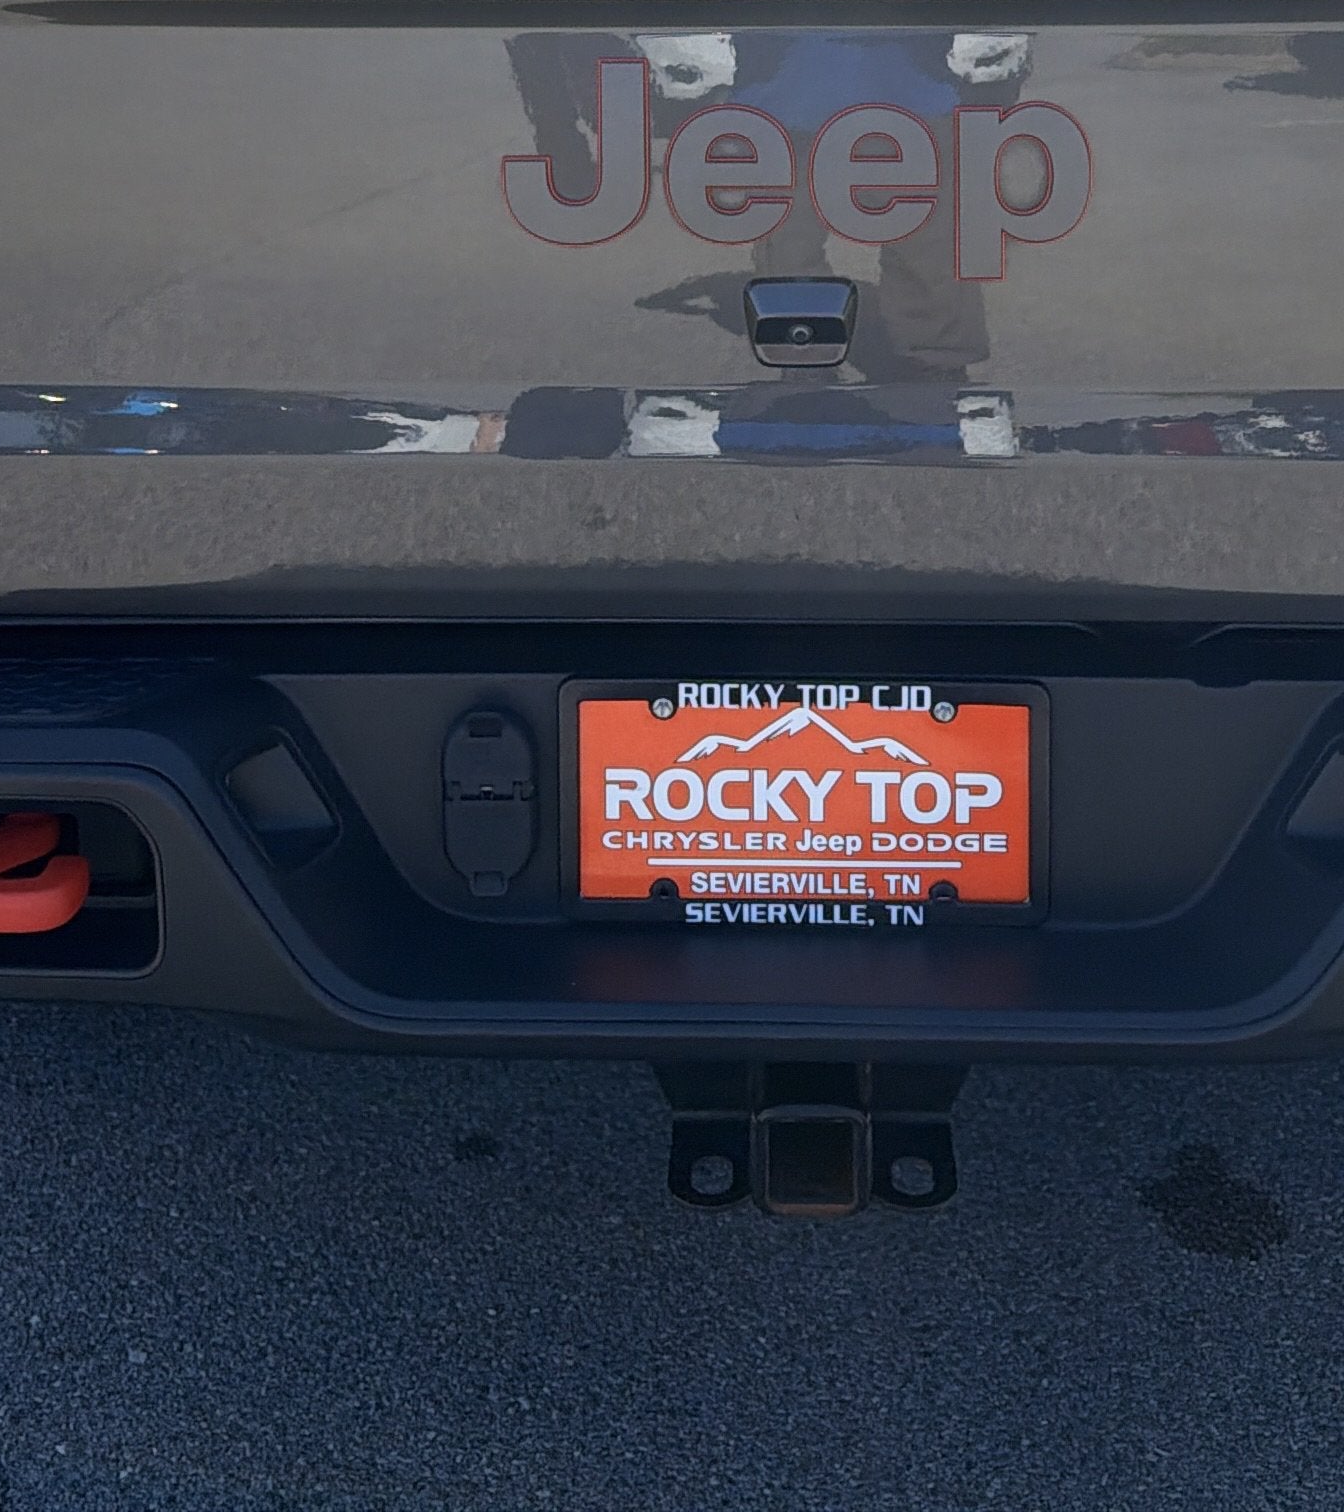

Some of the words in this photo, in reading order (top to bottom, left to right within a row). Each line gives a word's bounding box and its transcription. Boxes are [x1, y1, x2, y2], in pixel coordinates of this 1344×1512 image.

[501, 57, 1093, 281] Jeep
[677, 683, 785, 708] ROCKY
[796, 684, 861, 710] TOP
[871, 685, 932, 711] CJD
[603, 768, 844, 823] ROCKY
[855, 771, 1004, 825] TOP
[602, 830, 787, 852] CHRYSLER
[795, 829, 863, 855] Jeep
[871, 833, 1008, 854] DODGE
[690, 872, 876, 898] SEVIERVILLE,
[884, 875, 922, 896] TN
[684, 902, 876, 928] SEVIERVILLE,
[885, 905, 925, 926] TN
